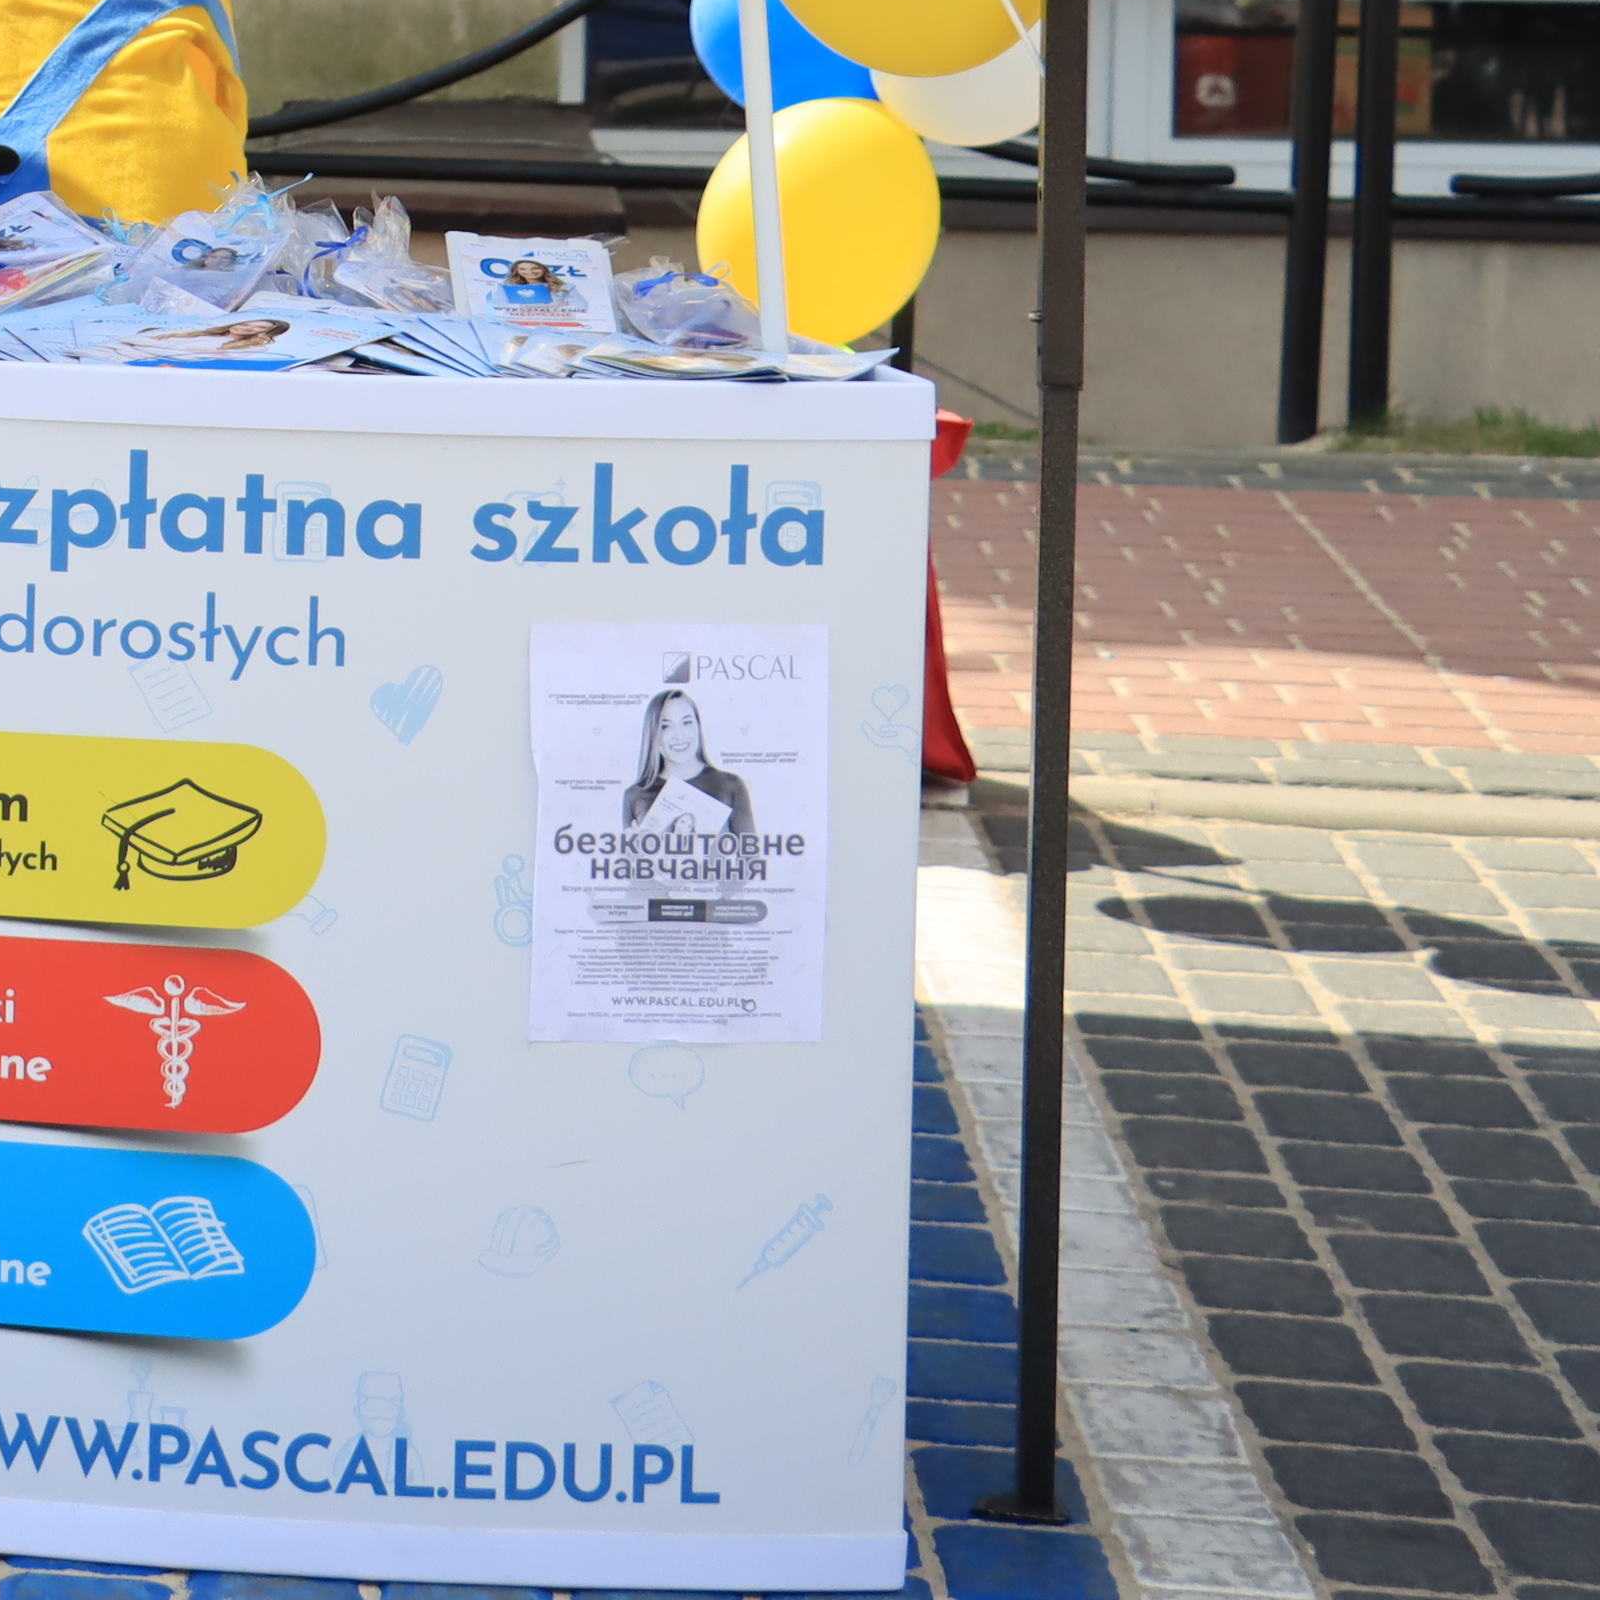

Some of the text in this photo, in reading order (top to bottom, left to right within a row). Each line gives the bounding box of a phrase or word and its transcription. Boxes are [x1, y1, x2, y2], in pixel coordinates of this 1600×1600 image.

[470, 462, 825, 567] szkoła
[696, 654, 802, 681] PASCAL
[553, 823, 805, 856] безкоштовне
[590, 856, 768, 881] навчання
[611, 996, 742, 1007] WWW.PASCAL.EDU.PL
